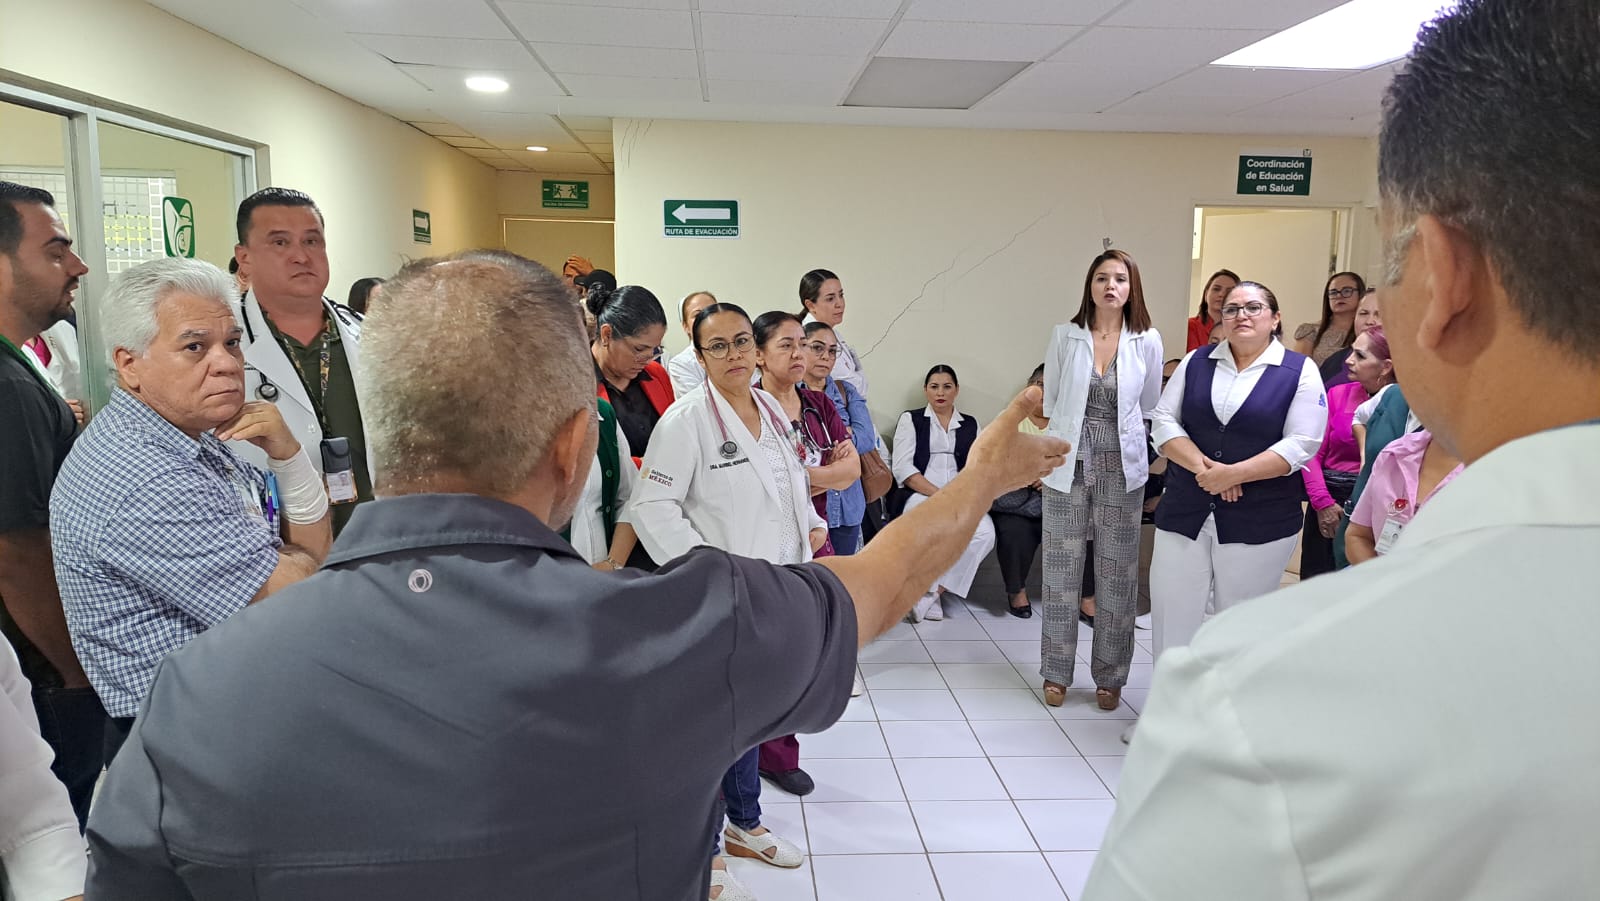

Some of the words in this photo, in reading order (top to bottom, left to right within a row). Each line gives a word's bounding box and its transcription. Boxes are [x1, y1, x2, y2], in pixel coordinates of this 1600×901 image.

[1246, 159, 1305, 168] Coordinación
[1245, 171, 1257, 179] de
[1259, 172, 1304, 180] Educación
[1269, 183, 1294, 192] Salud
[695, 227, 738, 235] EVACUACIÓN
